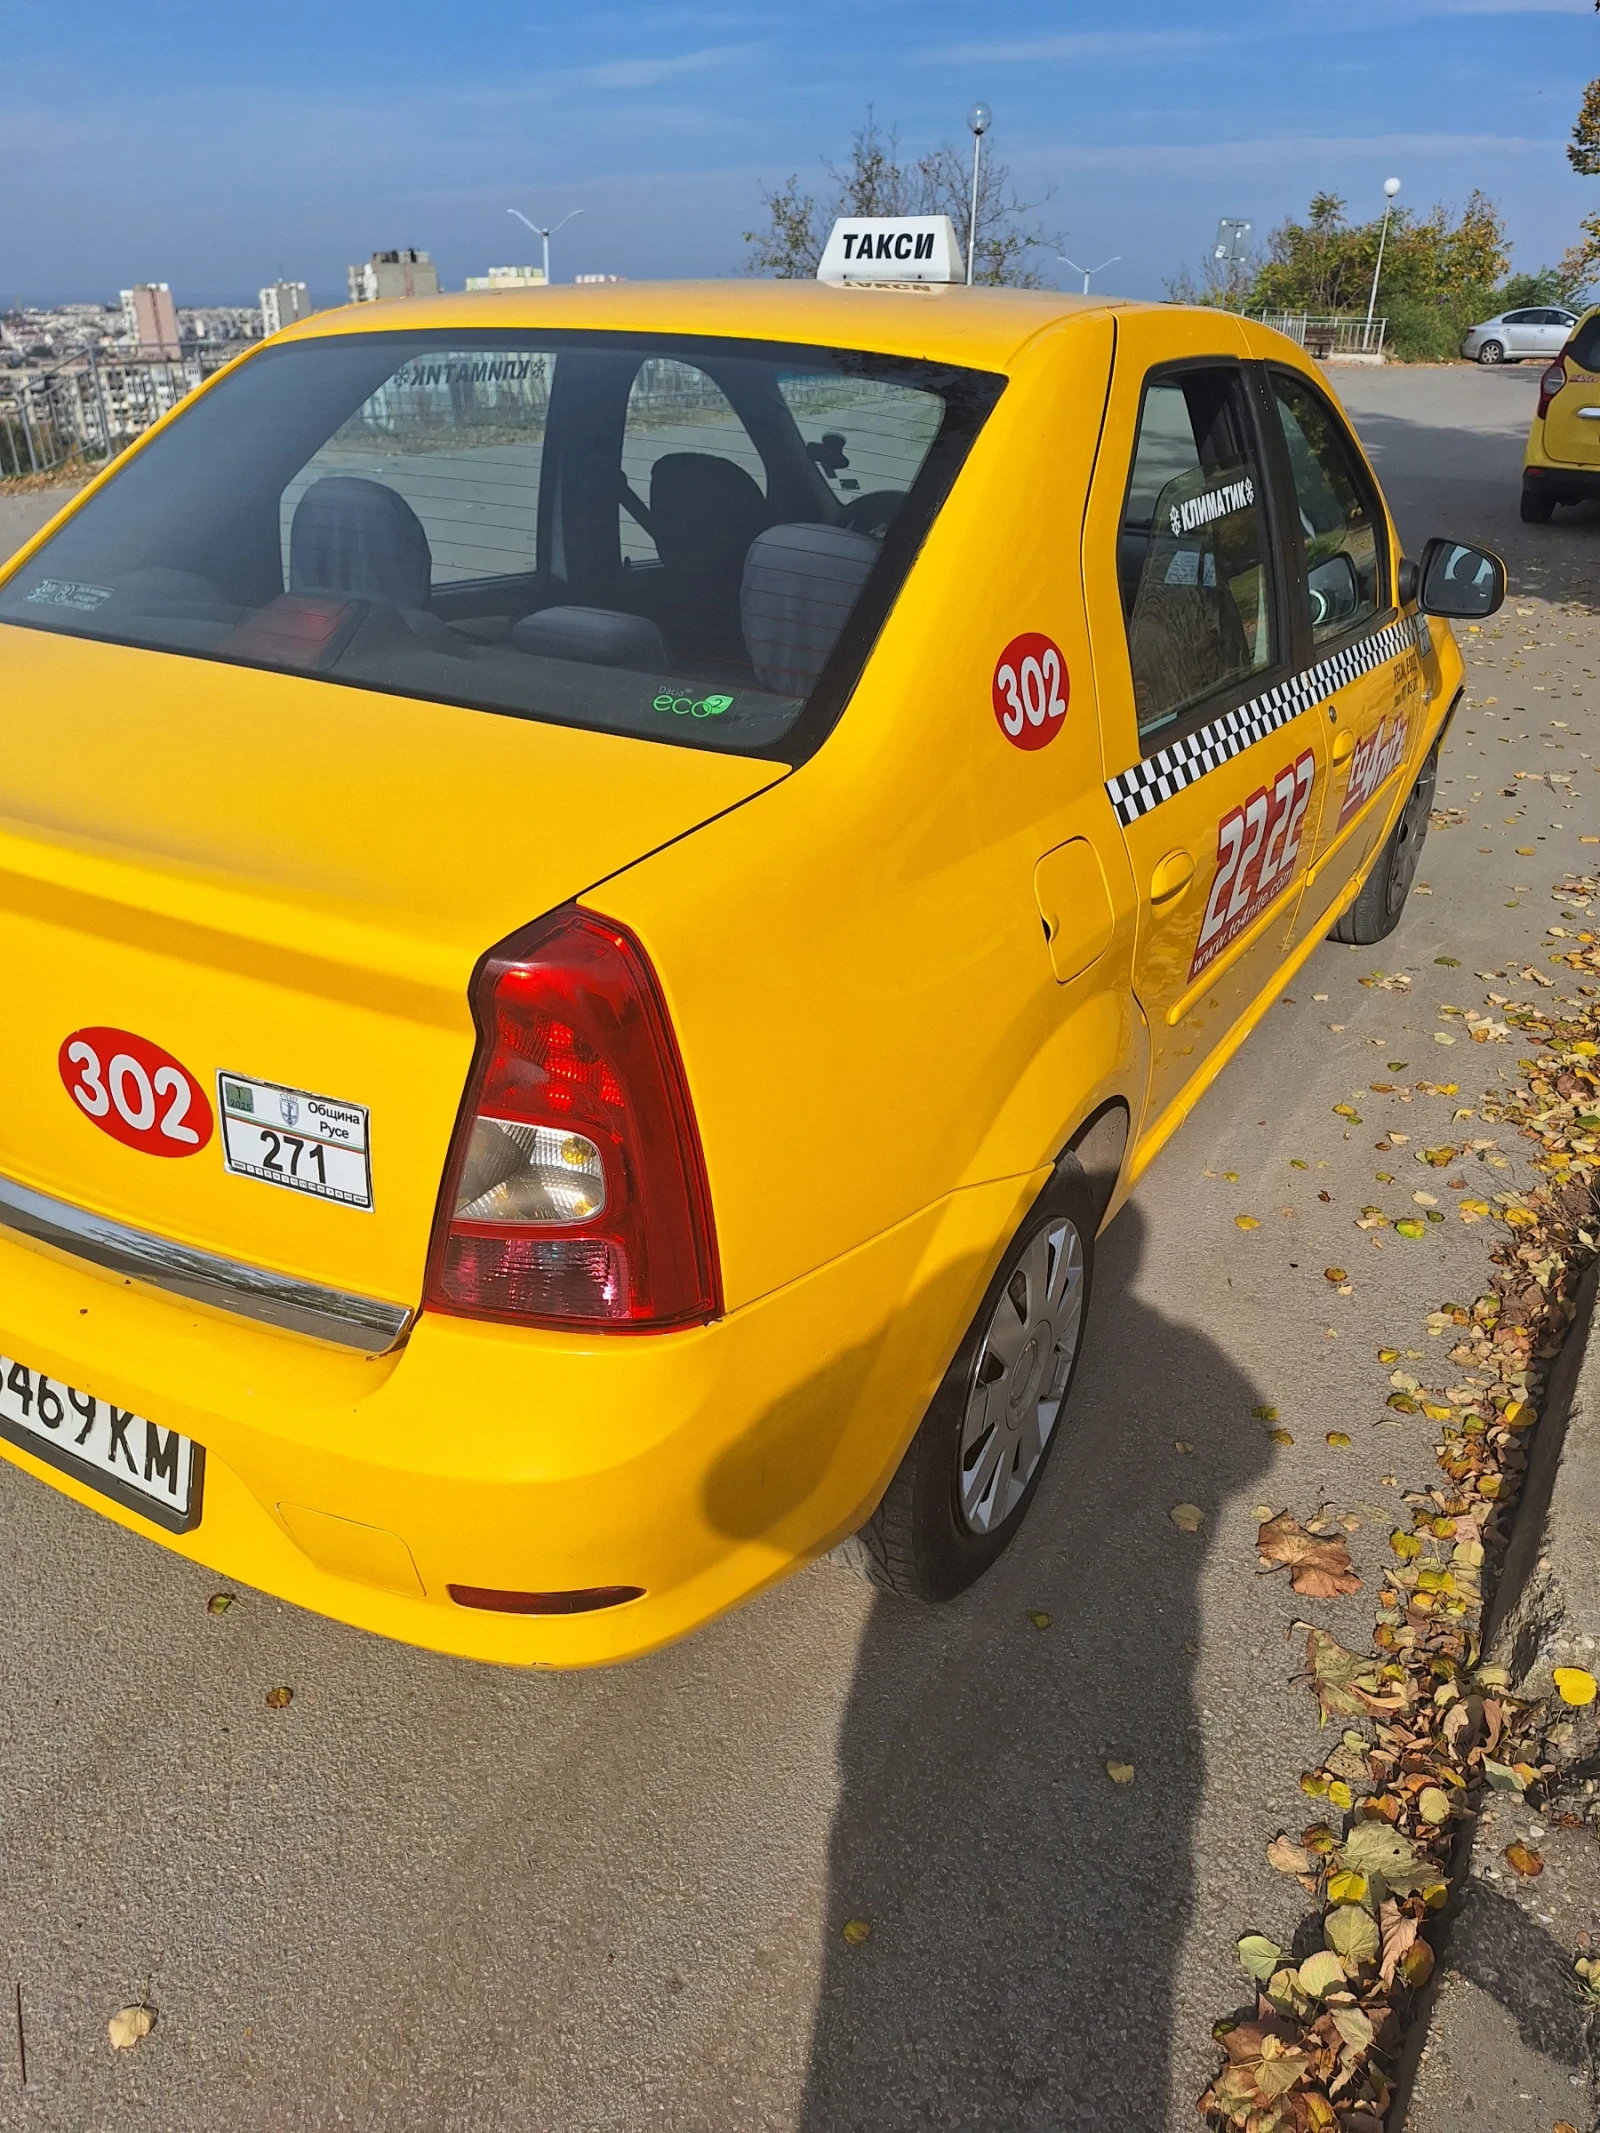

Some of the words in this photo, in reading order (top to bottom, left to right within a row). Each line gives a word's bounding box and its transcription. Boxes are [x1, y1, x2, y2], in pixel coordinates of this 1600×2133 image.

[843, 233, 935, 260] ТАКСИ
[1180, 480, 1248, 532] КЛИМАТИК
[658, 685, 685, 697] Dacia
[998, 648, 1066, 736] 302
[1193, 867, 1293, 974] www.to4nite.com
[68, 1041, 200, 1144] 302
[230, 1099, 252, 1111] 2025
[308, 1101, 361, 1125] Община
[319, 1121, 349, 1138] Русе
[260, 1130, 327, 1184] 271
